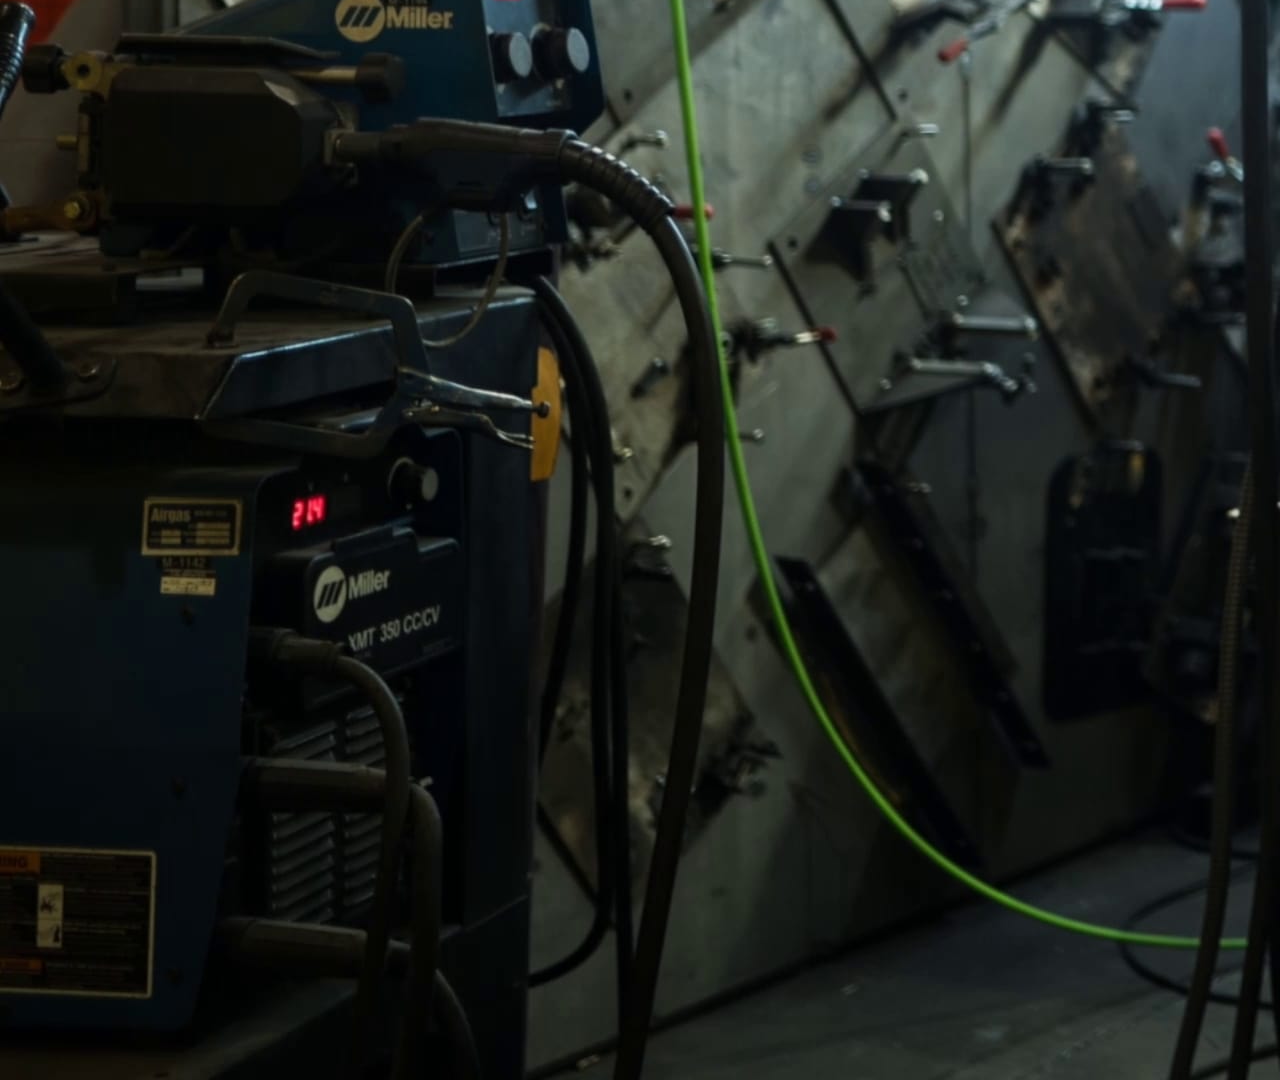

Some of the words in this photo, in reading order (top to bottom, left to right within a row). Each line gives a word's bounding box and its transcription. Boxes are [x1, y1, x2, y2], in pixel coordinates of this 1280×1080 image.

[386, 6, 454, 29] Miller
[150, 507, 192, 524] Airgas
[347, 569, 392, 601] Miller
[347, 626, 376, 653] XMT
[379, 619, 401, 644] 350
[402, 604, 442, 635] CC/CV
